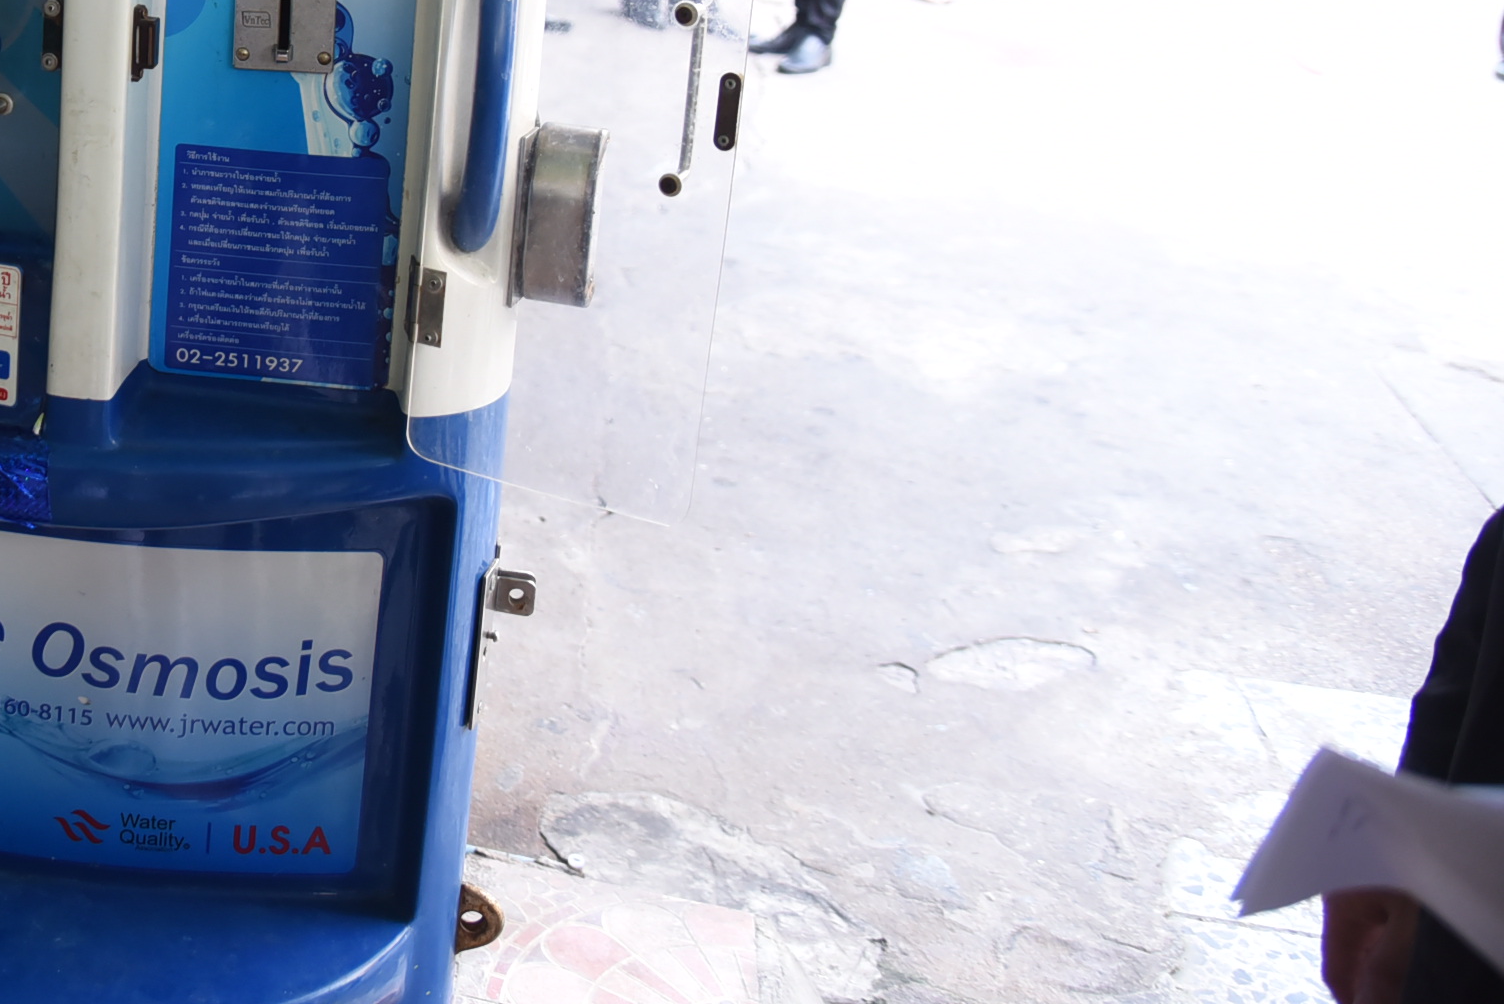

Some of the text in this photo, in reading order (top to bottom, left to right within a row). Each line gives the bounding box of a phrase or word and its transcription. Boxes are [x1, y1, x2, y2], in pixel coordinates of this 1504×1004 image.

[1, 271, 12, 287] ปี
[176, 348, 303, 373] 02-2511937
[30, 621, 355, 702] Osmosis
[106, 711, 335, 738] www.jrwater.com
[120, 811, 176, 831] Water
[120, 829, 185, 850] Quality
[233, 824, 332, 855] U.S.A
